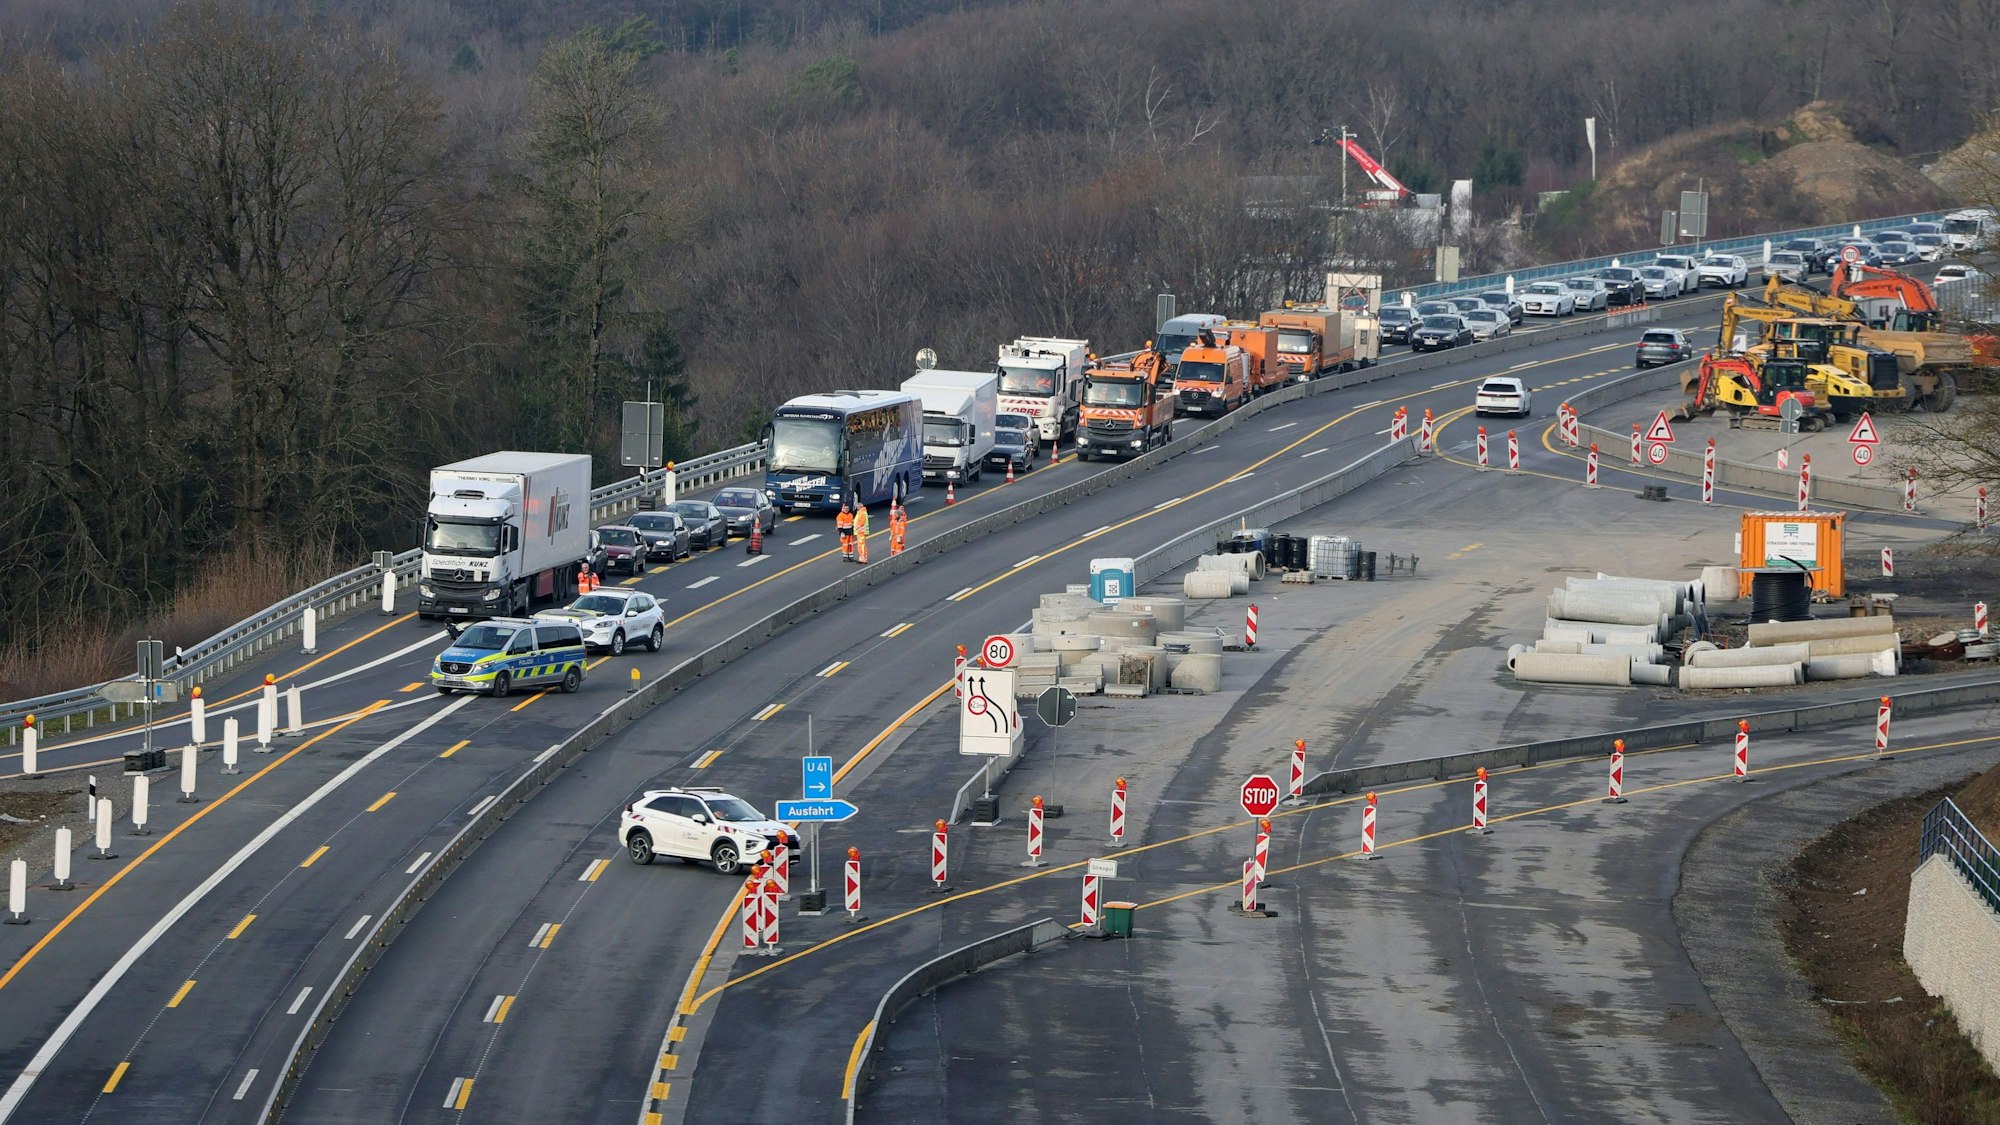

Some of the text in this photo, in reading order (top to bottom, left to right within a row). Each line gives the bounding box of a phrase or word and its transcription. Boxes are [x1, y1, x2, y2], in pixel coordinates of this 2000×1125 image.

[1652, 447, 1664, 459] 40
[1856, 449, 1869, 460] 40
[431, 558, 489, 568] Spedition KUNZ
[989, 644, 1008, 659] 80
[807, 762, 827, 772] U 41
[1244, 788, 1276, 804] STOP
[788, 806, 835, 816] Ausfahrt
